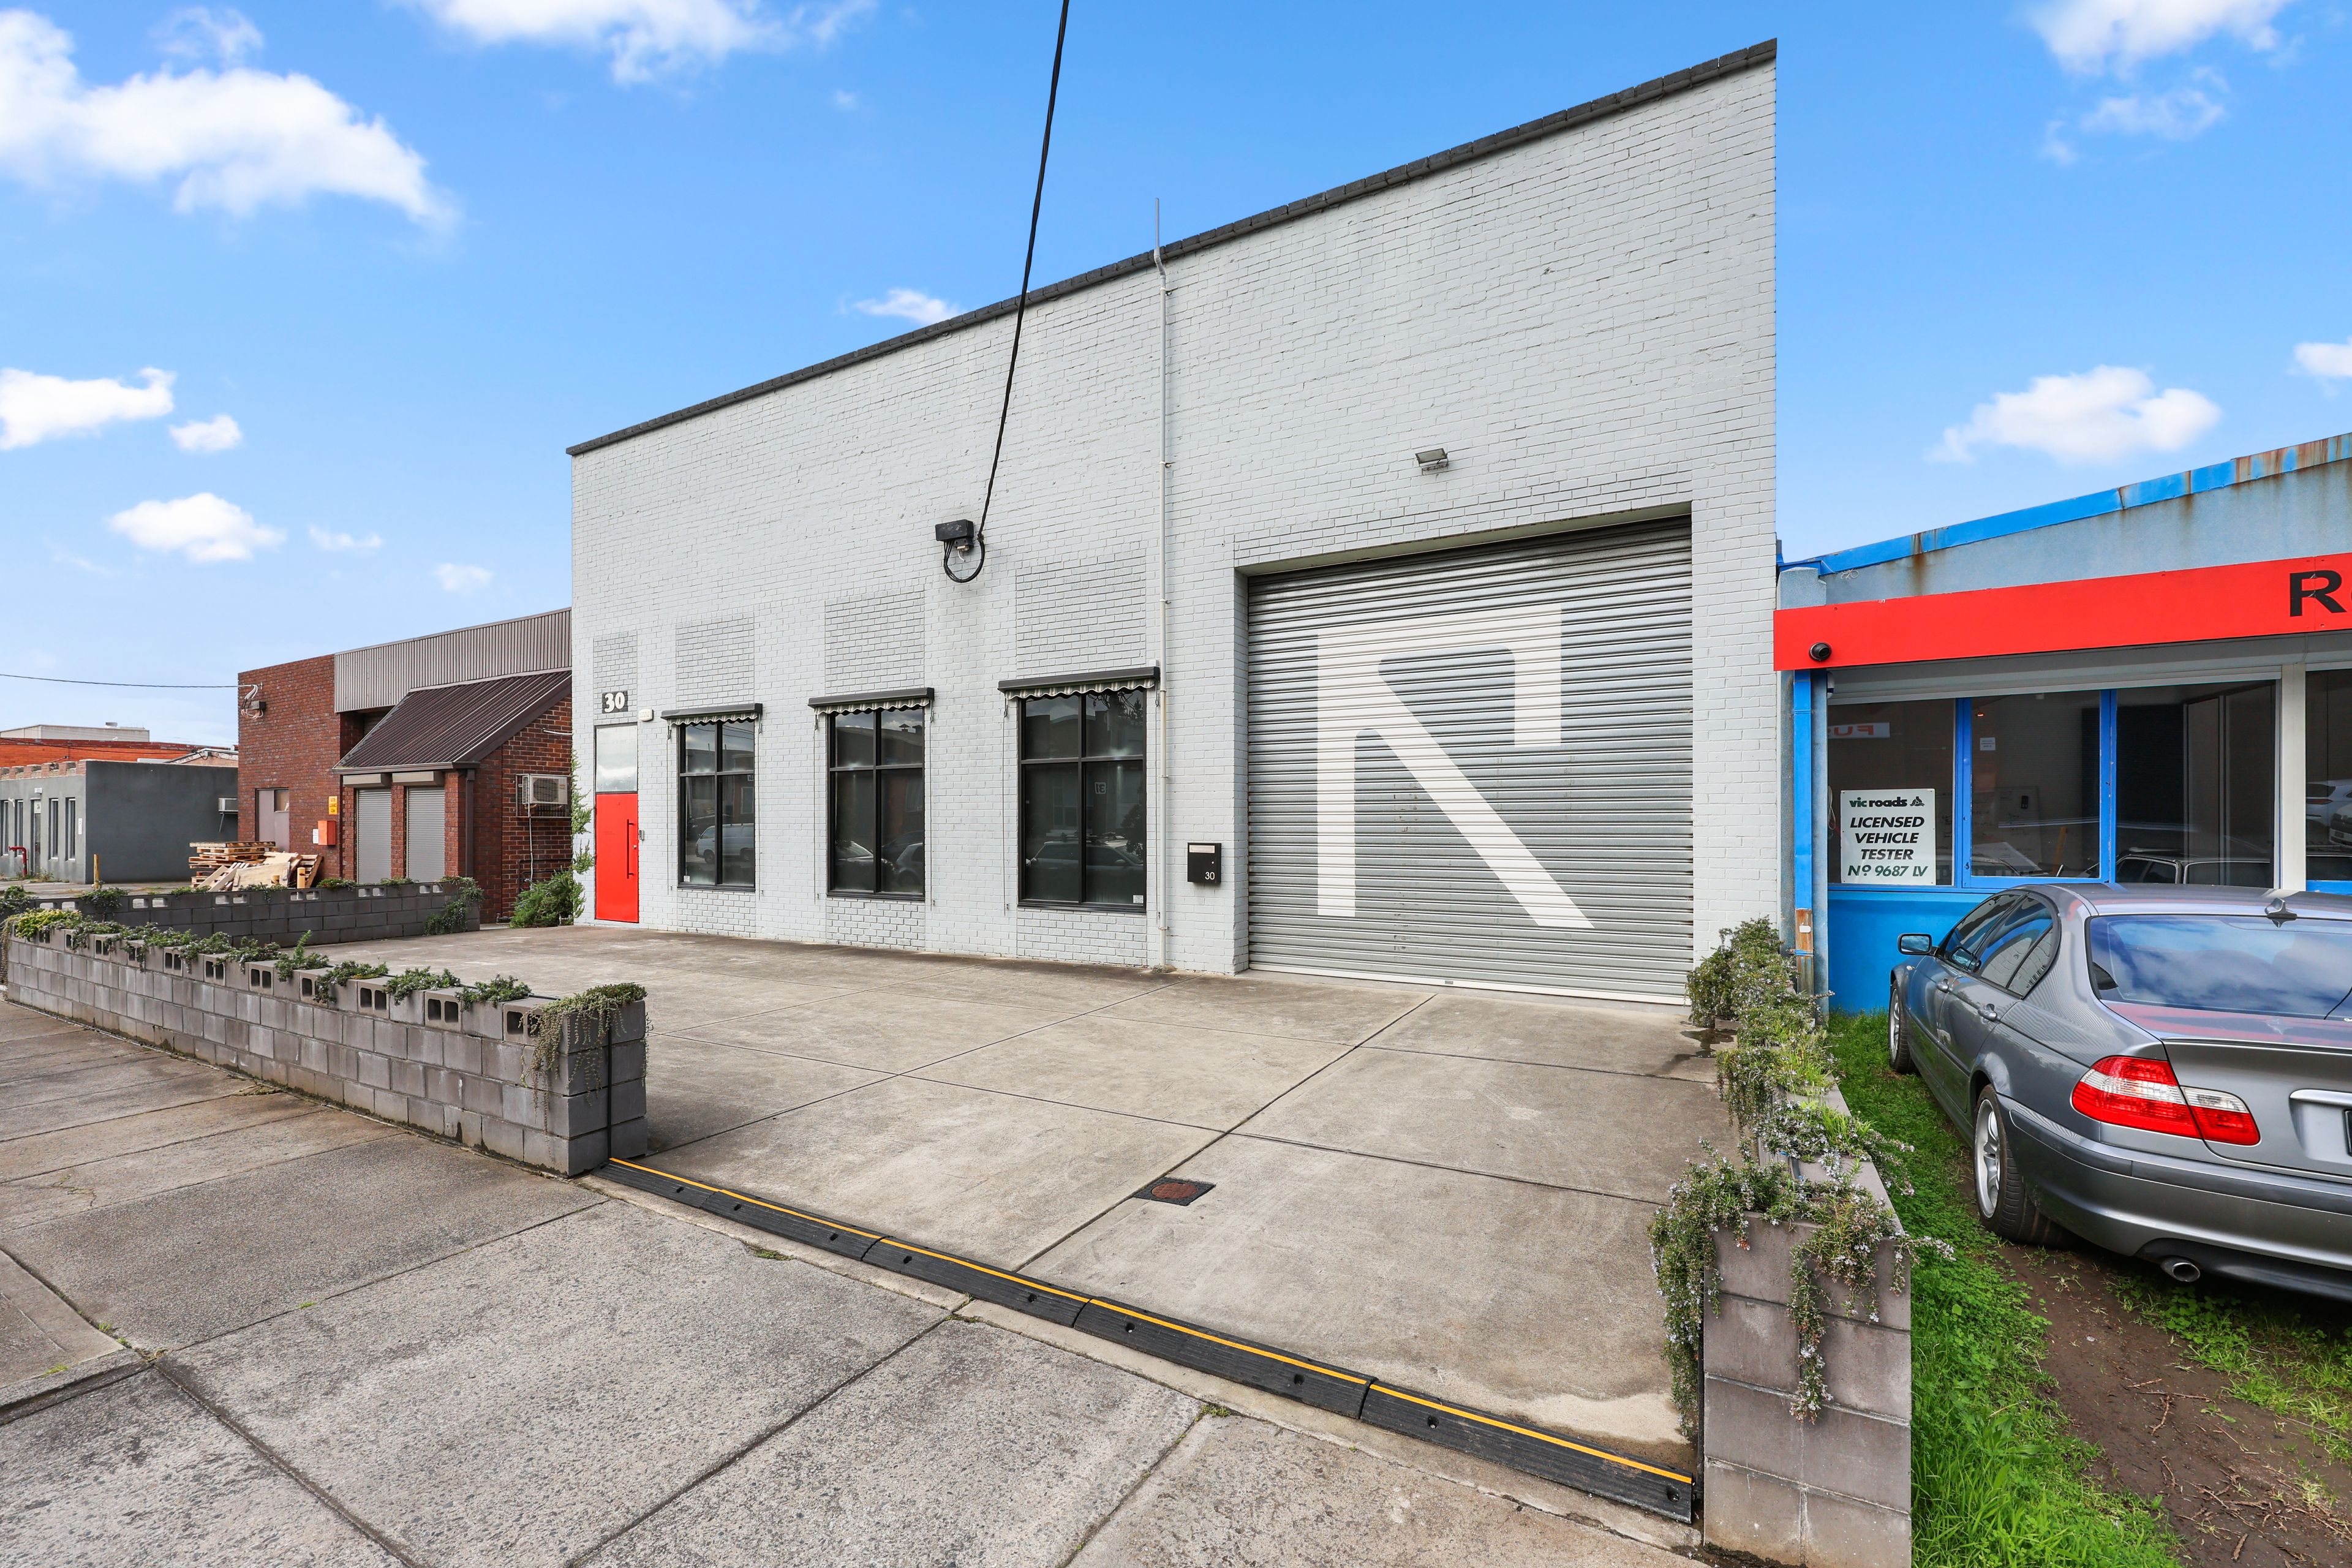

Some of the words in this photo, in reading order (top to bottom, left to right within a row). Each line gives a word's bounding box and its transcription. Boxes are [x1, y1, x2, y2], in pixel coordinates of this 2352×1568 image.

[2290, 570, 2352, 617] R
[604, 692, 625, 713] 30
[1317, 603, 1595, 929] R
[1850, 816, 1925, 828] LICENSED
[1855, 832, 1920, 843] VEHICLE
[1861, 849, 1914, 860] TESTER
[1205, 872, 1215, 880] 30
[1874, 865, 1910, 877] 9687
[1912, 865, 1928, 877] LV
